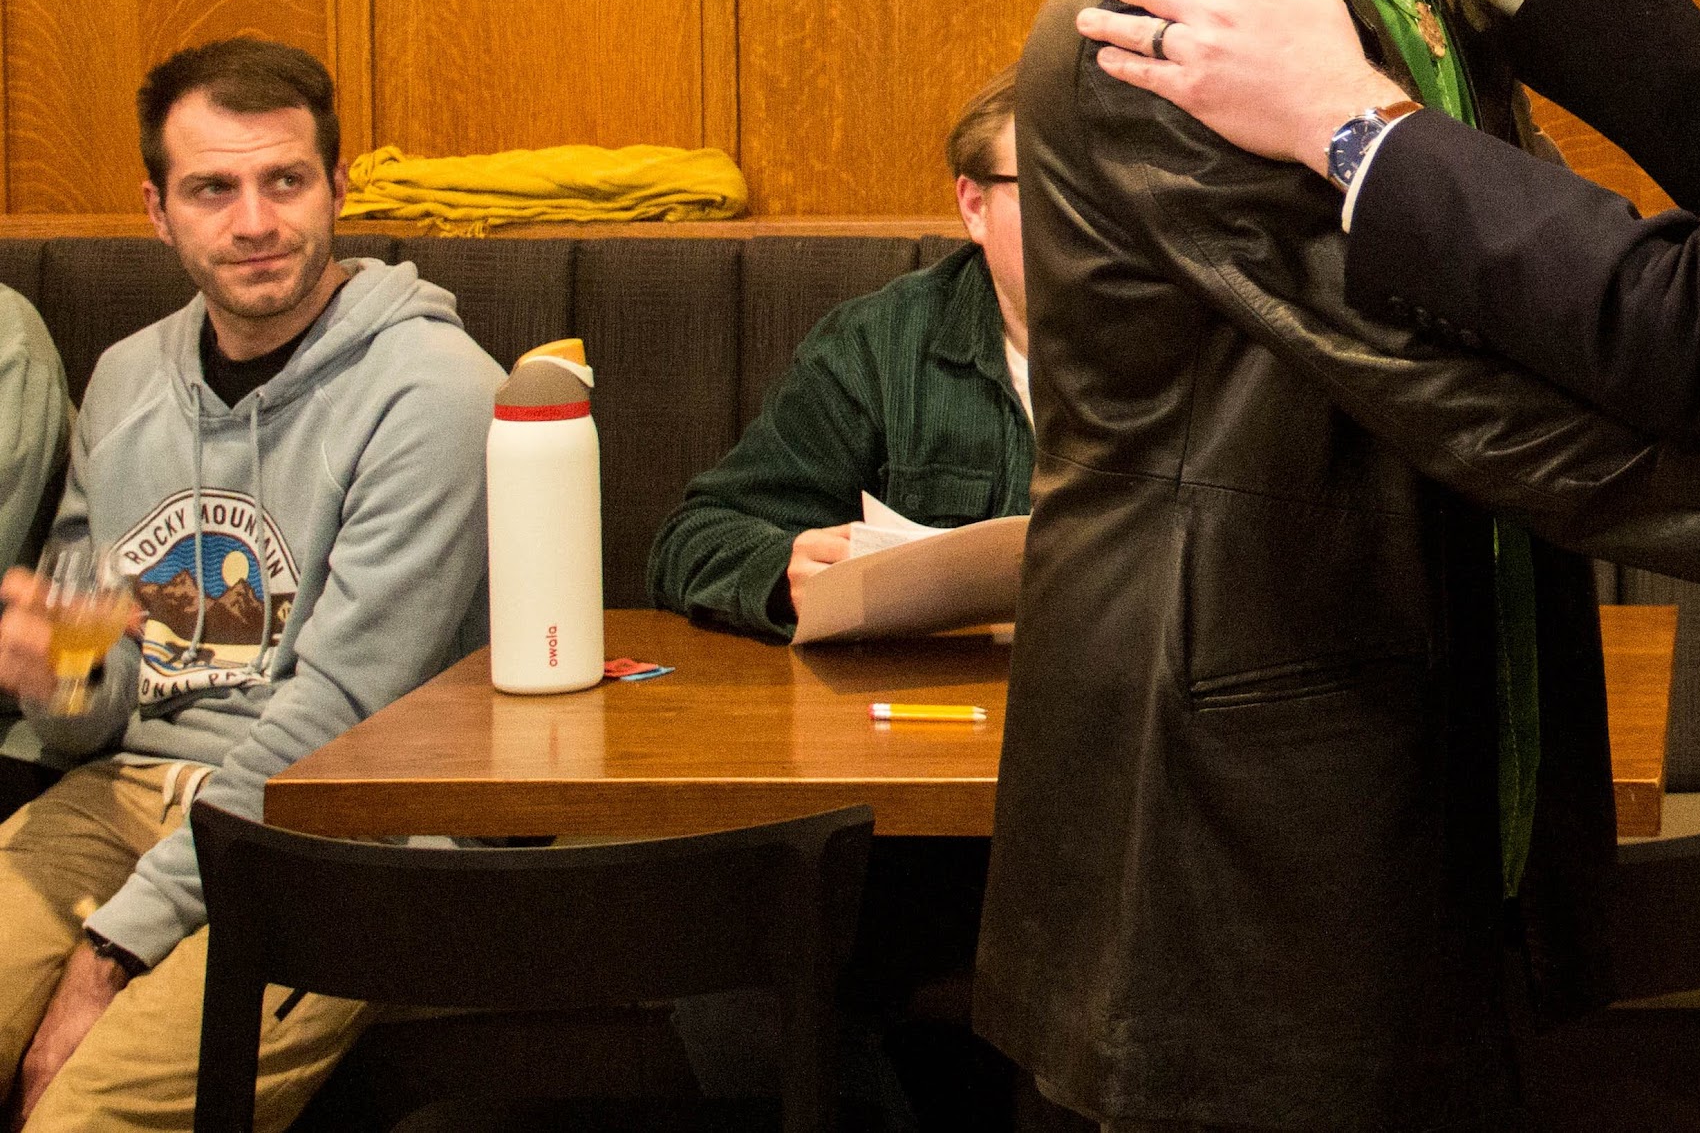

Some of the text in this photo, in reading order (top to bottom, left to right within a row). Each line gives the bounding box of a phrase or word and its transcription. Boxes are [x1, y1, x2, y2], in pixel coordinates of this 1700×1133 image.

[124, 503, 284, 579] ROCKY MOUNAIN
[545, 626, 558, 667] owala
